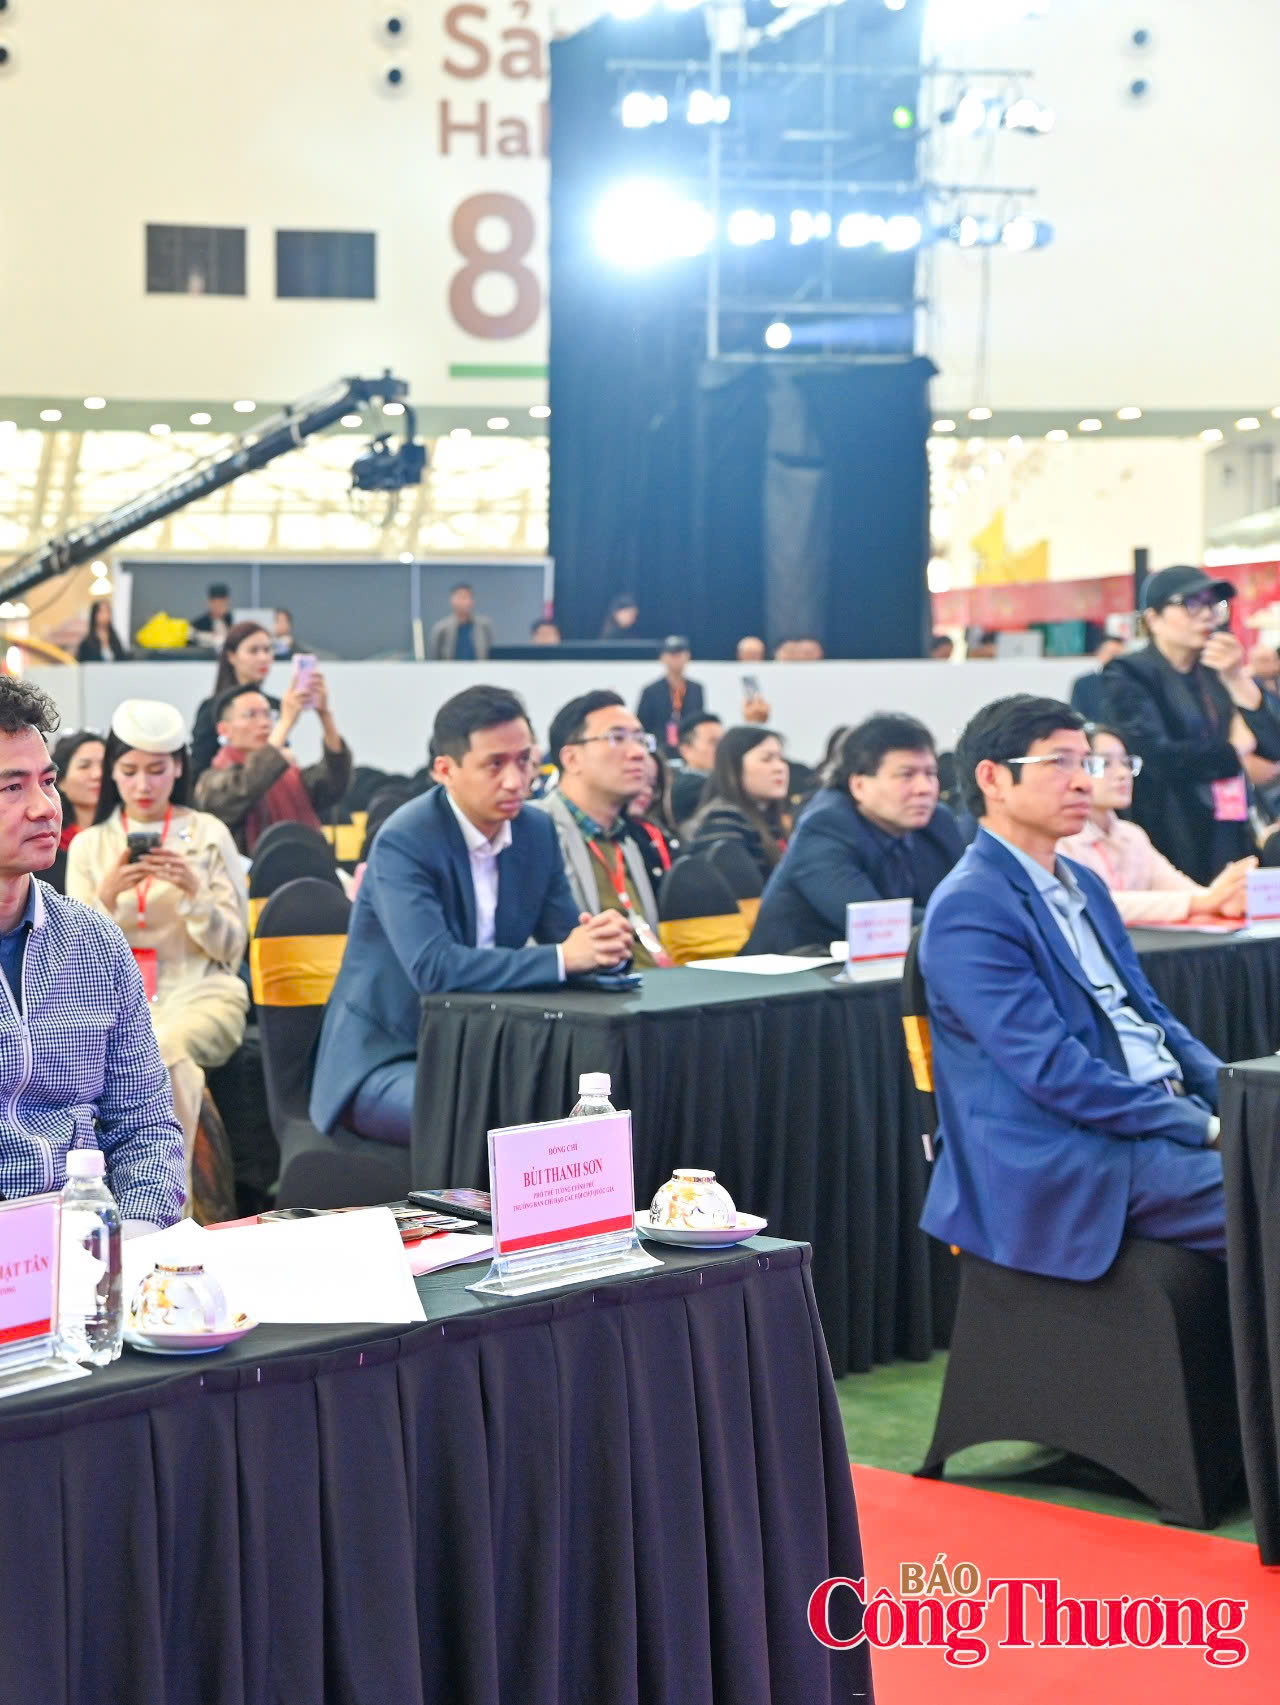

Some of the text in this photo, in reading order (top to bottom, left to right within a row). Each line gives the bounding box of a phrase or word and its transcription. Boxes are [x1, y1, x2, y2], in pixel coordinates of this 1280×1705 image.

[442, 0, 568, 80] Sả
[437, 99, 550, 158] Hal
[448, 191, 542, 341] 8
[523, 1158, 603, 1187] BÙI THANH SƠN
